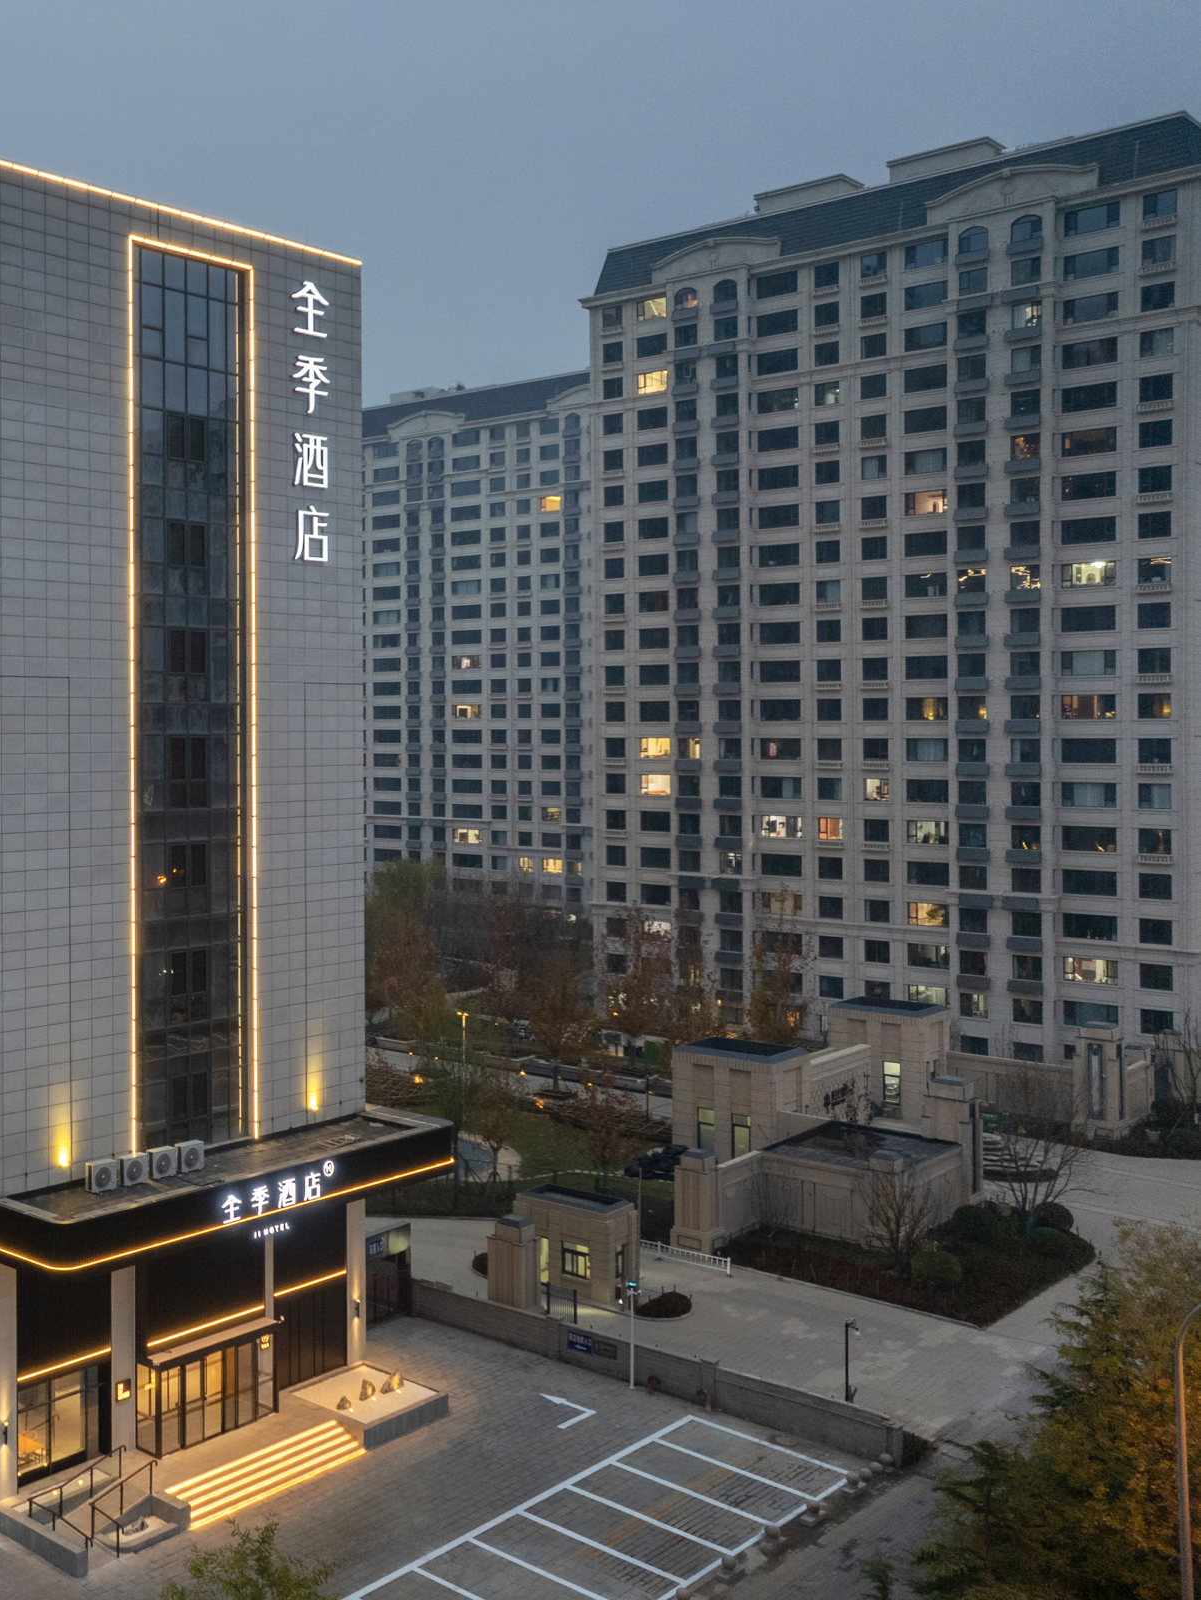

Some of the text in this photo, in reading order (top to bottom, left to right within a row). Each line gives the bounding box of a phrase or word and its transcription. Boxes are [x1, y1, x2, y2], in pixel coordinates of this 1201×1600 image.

[291, 280, 331, 563] 全季酒店
[222, 1172, 321, 1224] 全季酒店
[263, 1222, 290, 1236] HOTEL
